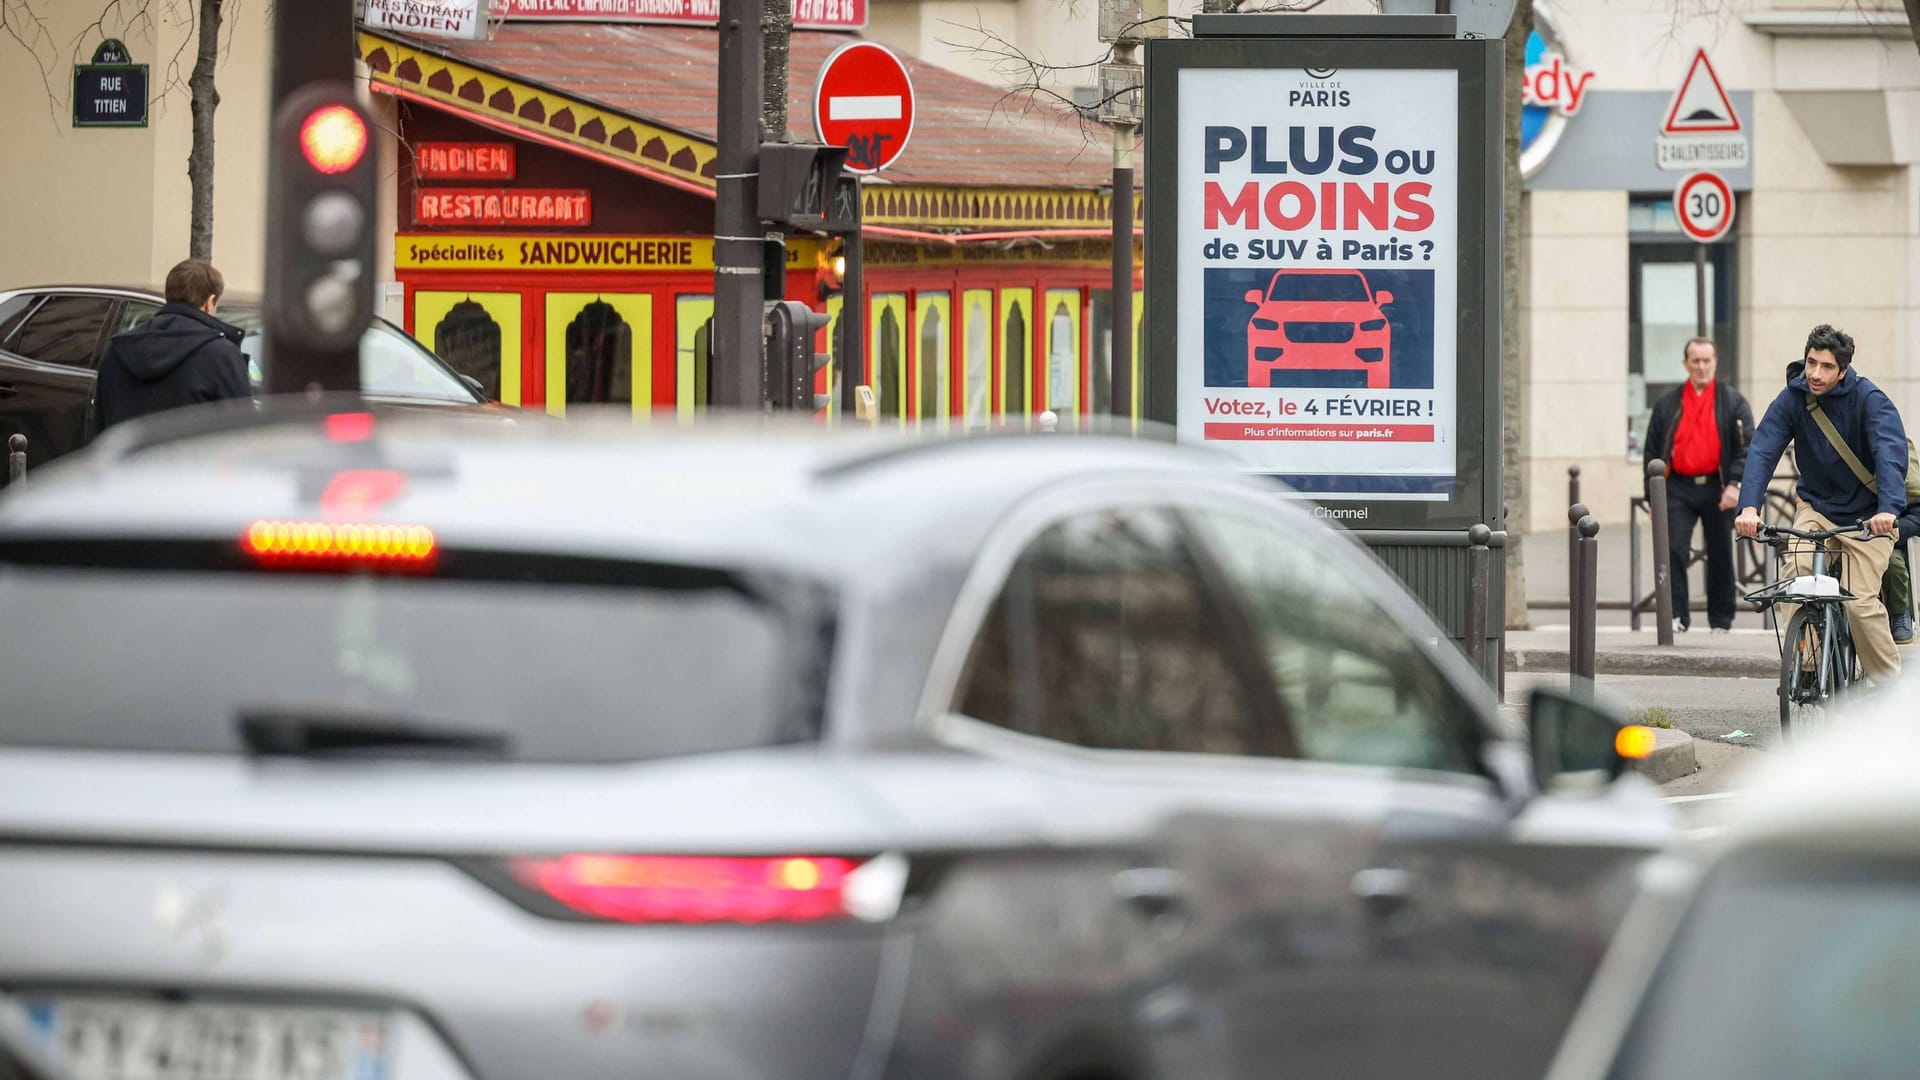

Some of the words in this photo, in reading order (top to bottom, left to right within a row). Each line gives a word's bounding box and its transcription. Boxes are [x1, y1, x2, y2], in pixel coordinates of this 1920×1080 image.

[381, 12, 460, 31] INDIEN
[100, 77, 122, 91] RUE
[1299, 81, 1325, 89] VILLE
[94, 98, 127, 113] TITIEN
[1289, 90, 1351, 107] PARIS
[421, 148, 508, 172] INDIEN
[1204, 125, 1379, 175] PLUS
[1661, 144, 1668, 162] 2
[422, 195, 588, 220] RESTAURANT
[1203, 180, 1436, 232] MOINS
[1691, 192, 1720, 218] 30
[410, 244, 504, 263] Spécialités
[519, 241, 692, 265] SANDWICHERIE
[1203, 238, 1239, 260] de
[1247, 239, 1309, 260] SUV
[1316, 237, 1332, 260] à
[1204, 397, 1272, 418] Votez,
[1279, 397, 1298, 415] le
[1303, 399, 1319, 416] 4
[1326, 395, 1422, 417] FÉVRIER
[1244, 427, 1266, 437] Plus
[1267, 427, 1337, 438] d'informations
[1339, 430, 1355, 438] sur
[1356, 428, 1394, 439] paris.fr
[1314, 506, 1368, 519] Channel
